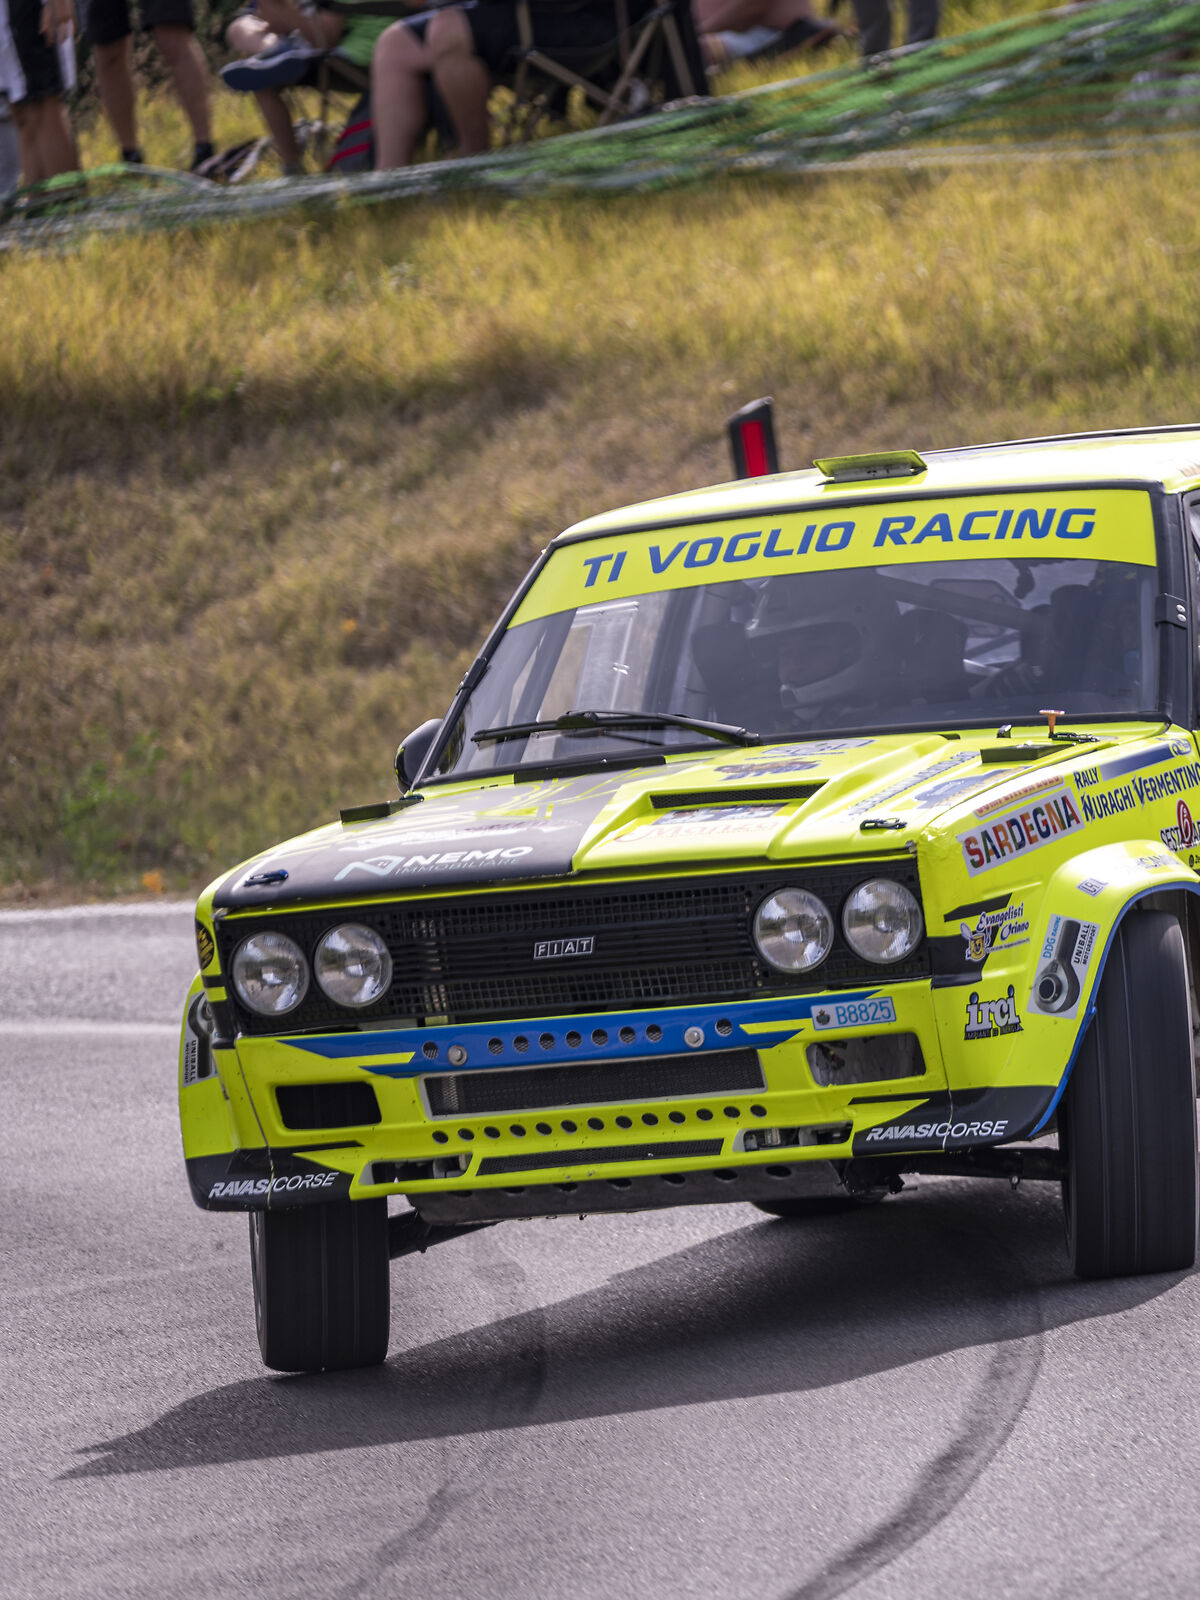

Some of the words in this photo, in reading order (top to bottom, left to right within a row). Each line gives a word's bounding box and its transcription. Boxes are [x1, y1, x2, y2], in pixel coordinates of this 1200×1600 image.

[583, 551, 627, 588] TI
[649, 520, 857, 574] VOGLIO
[873, 507, 1097, 548] RACING
[1073, 766, 1100, 793] RALLY
[1081, 788, 1137, 826] NURAGHI
[963, 794, 1080, 869] SARDEGNA
[403, 846, 533, 868] NEMO
[976, 902, 1024, 933] Evangelisti
[534, 936, 596, 960] FIAT
[1042, 938, 1056, 960] DDG
[1073, 923, 1091, 964] UNIBALL
[1082, 925, 1098, 966] MOTORSPORT
[836, 1000, 892, 1025] B8825
[965, 984, 1021, 1033] irci
[865, 1120, 1009, 1141] RAVASICORSE
[208, 1172, 340, 1200] RAVASICORSE
